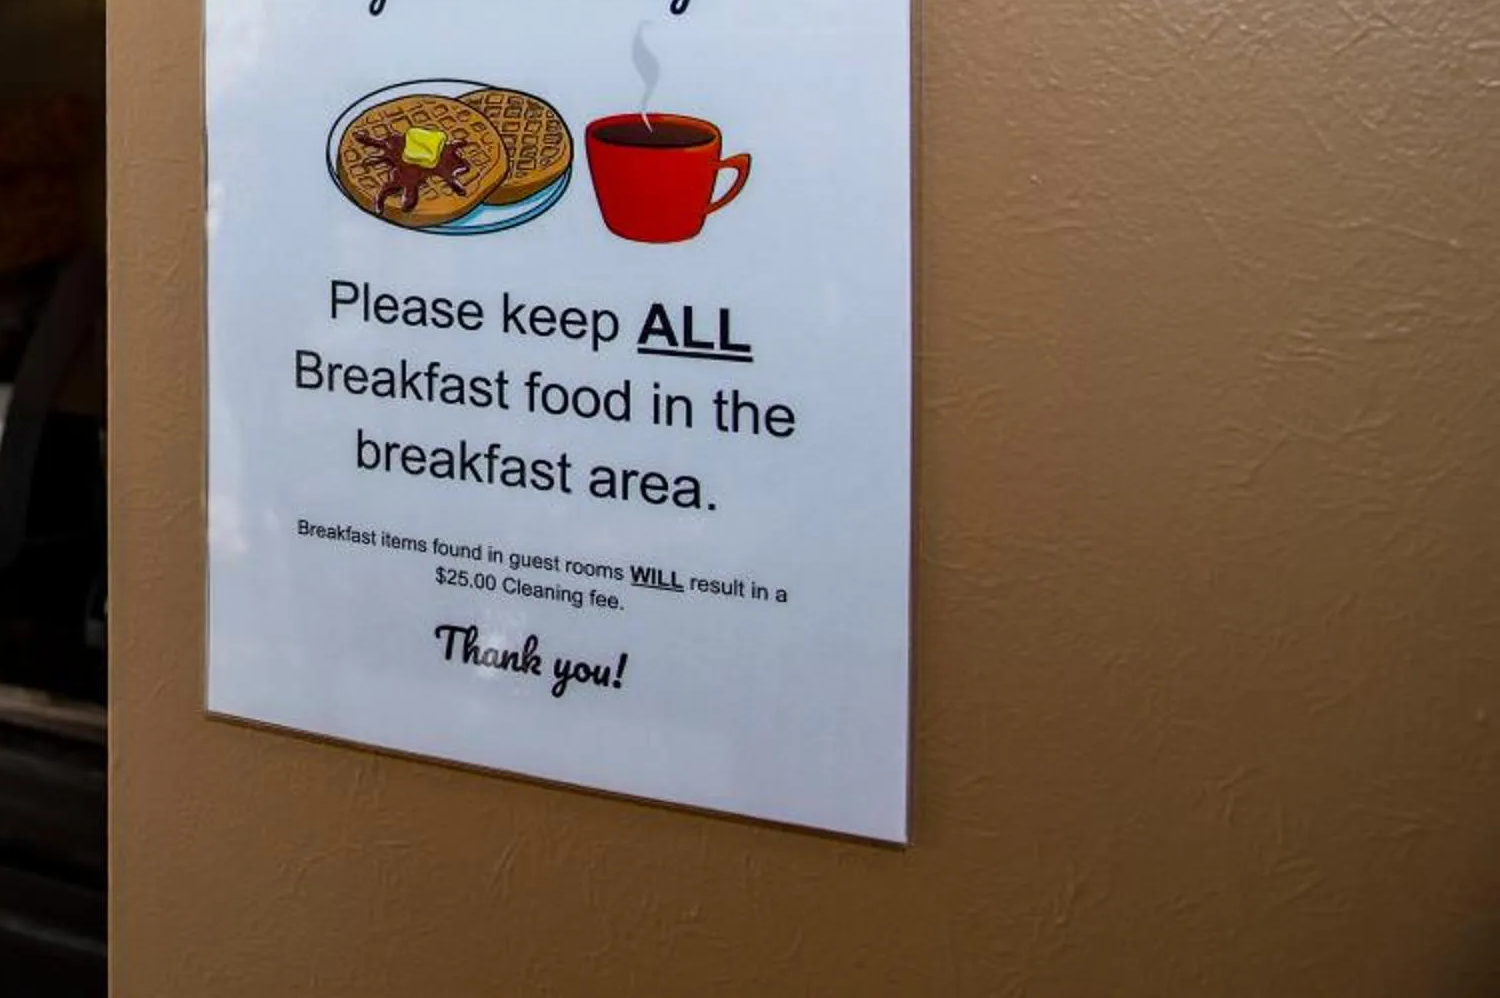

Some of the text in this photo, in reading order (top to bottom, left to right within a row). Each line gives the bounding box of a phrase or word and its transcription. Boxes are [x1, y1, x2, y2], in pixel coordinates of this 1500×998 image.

[331, 279, 754, 364] Please keep ALL
[295, 349, 796, 438] Breakfast food in the
[356, 428, 716, 511] breakfast area.
[297, 519, 788, 603] Breakfast items found in guest rooms WILL result in a
[435, 565, 625, 611] $25.00 Cleaning fee.
[433, 624, 629, 699] Thank you!
